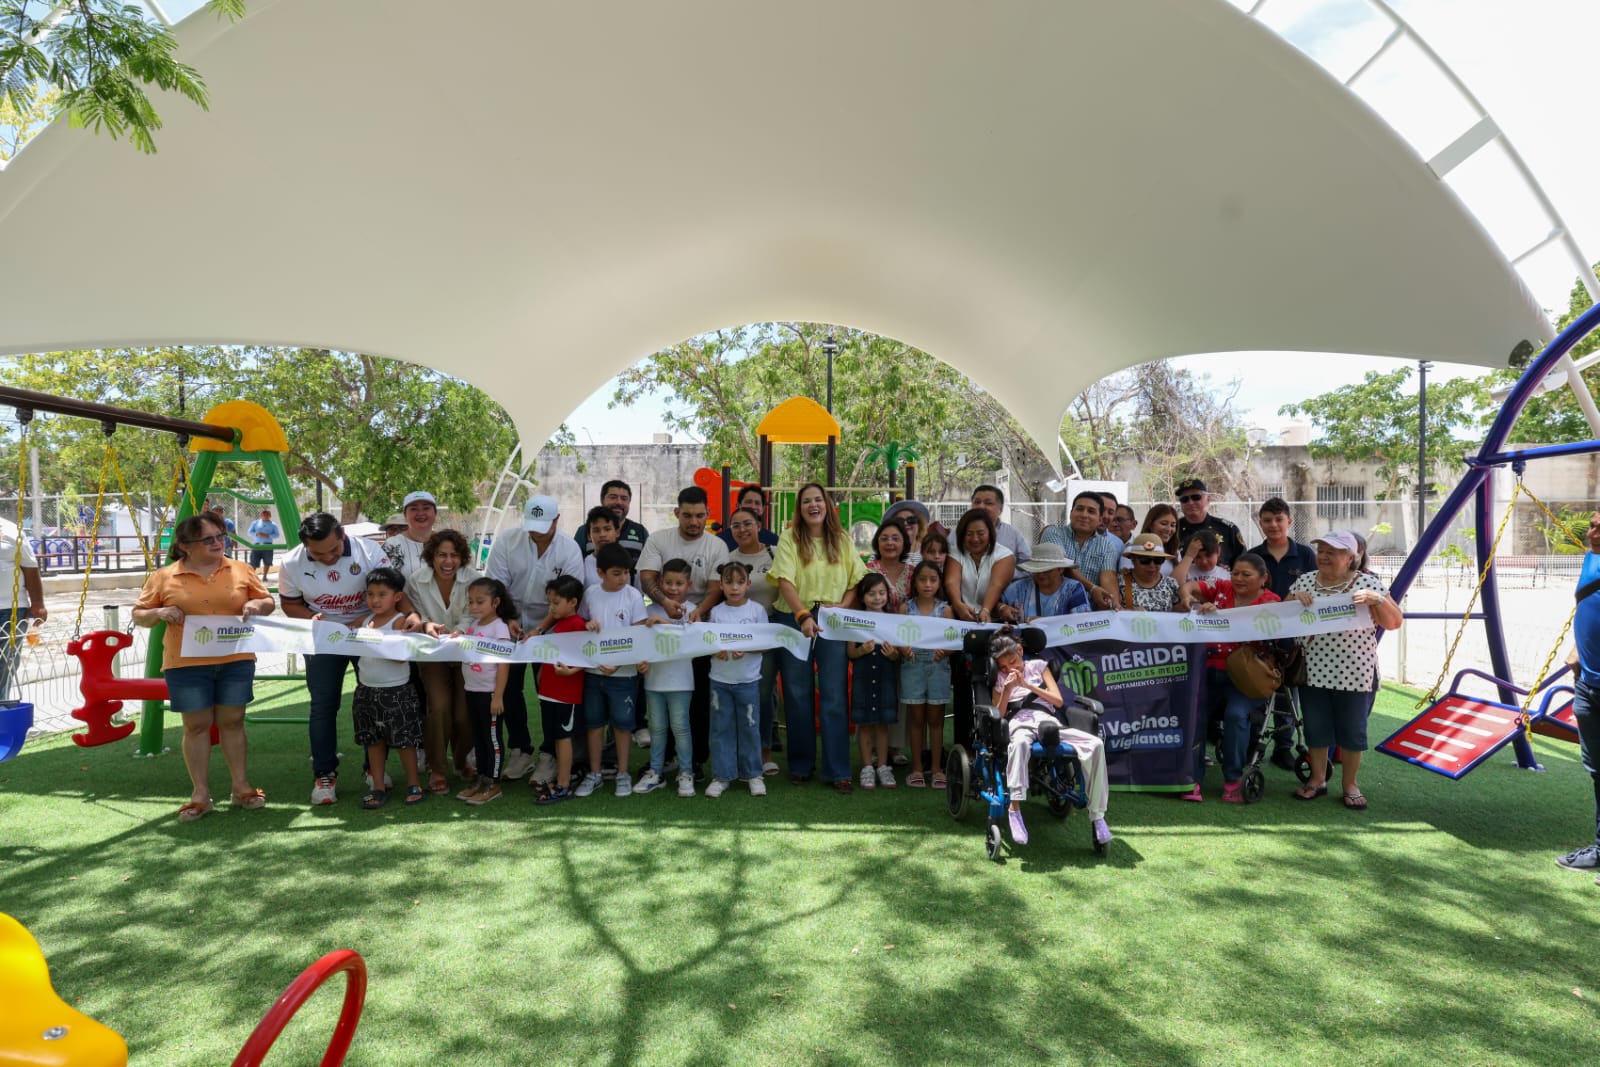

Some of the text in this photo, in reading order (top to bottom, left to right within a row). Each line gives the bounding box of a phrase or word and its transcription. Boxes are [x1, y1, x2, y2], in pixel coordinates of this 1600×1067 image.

[600, 637, 634, 648] MÉRIDA
[1101, 644, 1188, 673] MÉRIDA
[1106, 664, 1187, 682] CONTIGO ES MEJOR
[1106, 679, 1155, 692] AYUNTAMIENTO
[1106, 714, 1180, 736] Vecinos
